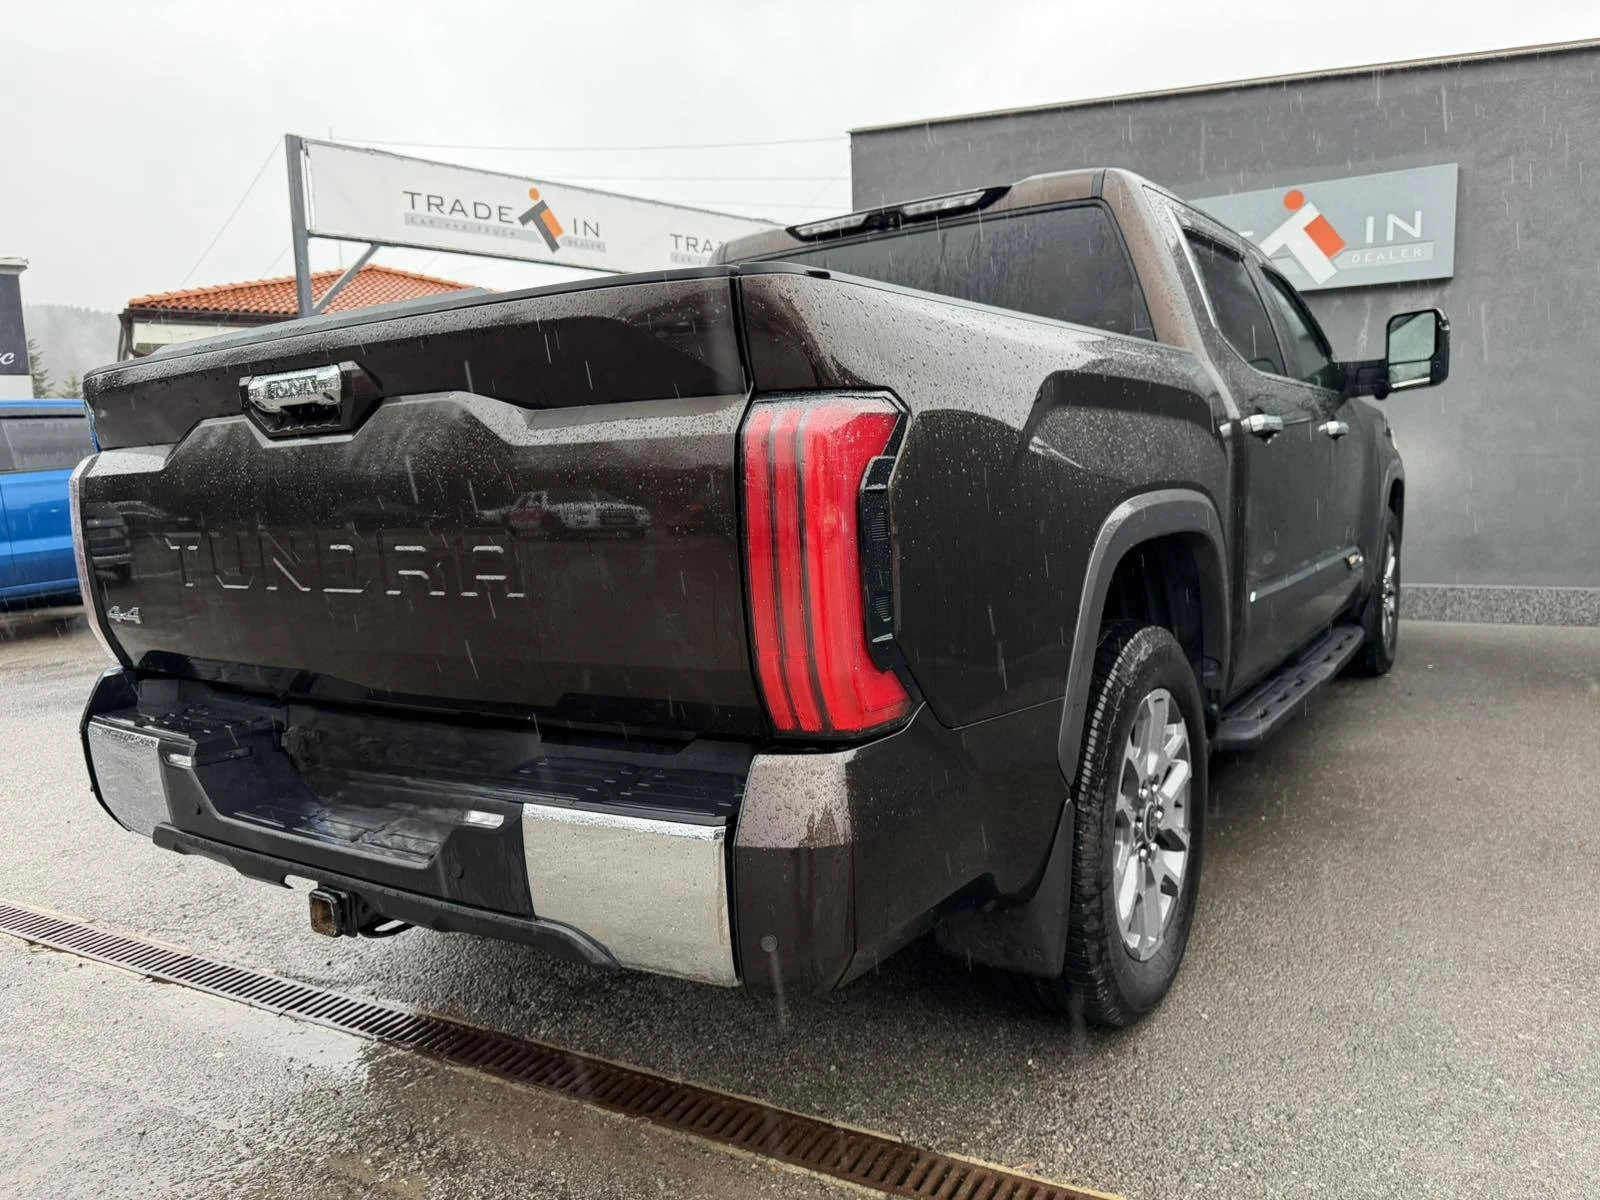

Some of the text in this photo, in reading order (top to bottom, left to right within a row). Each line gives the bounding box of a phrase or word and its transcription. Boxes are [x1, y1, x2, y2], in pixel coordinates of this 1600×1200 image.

[402, 190, 514, 224] TRADE
[573, 217, 600, 238] IN
[1366, 210, 1422, 244] IN
[669, 233, 722, 254] TRA
[1351, 247, 1424, 264] DEALER
[163, 531, 526, 599] TUNDRA
